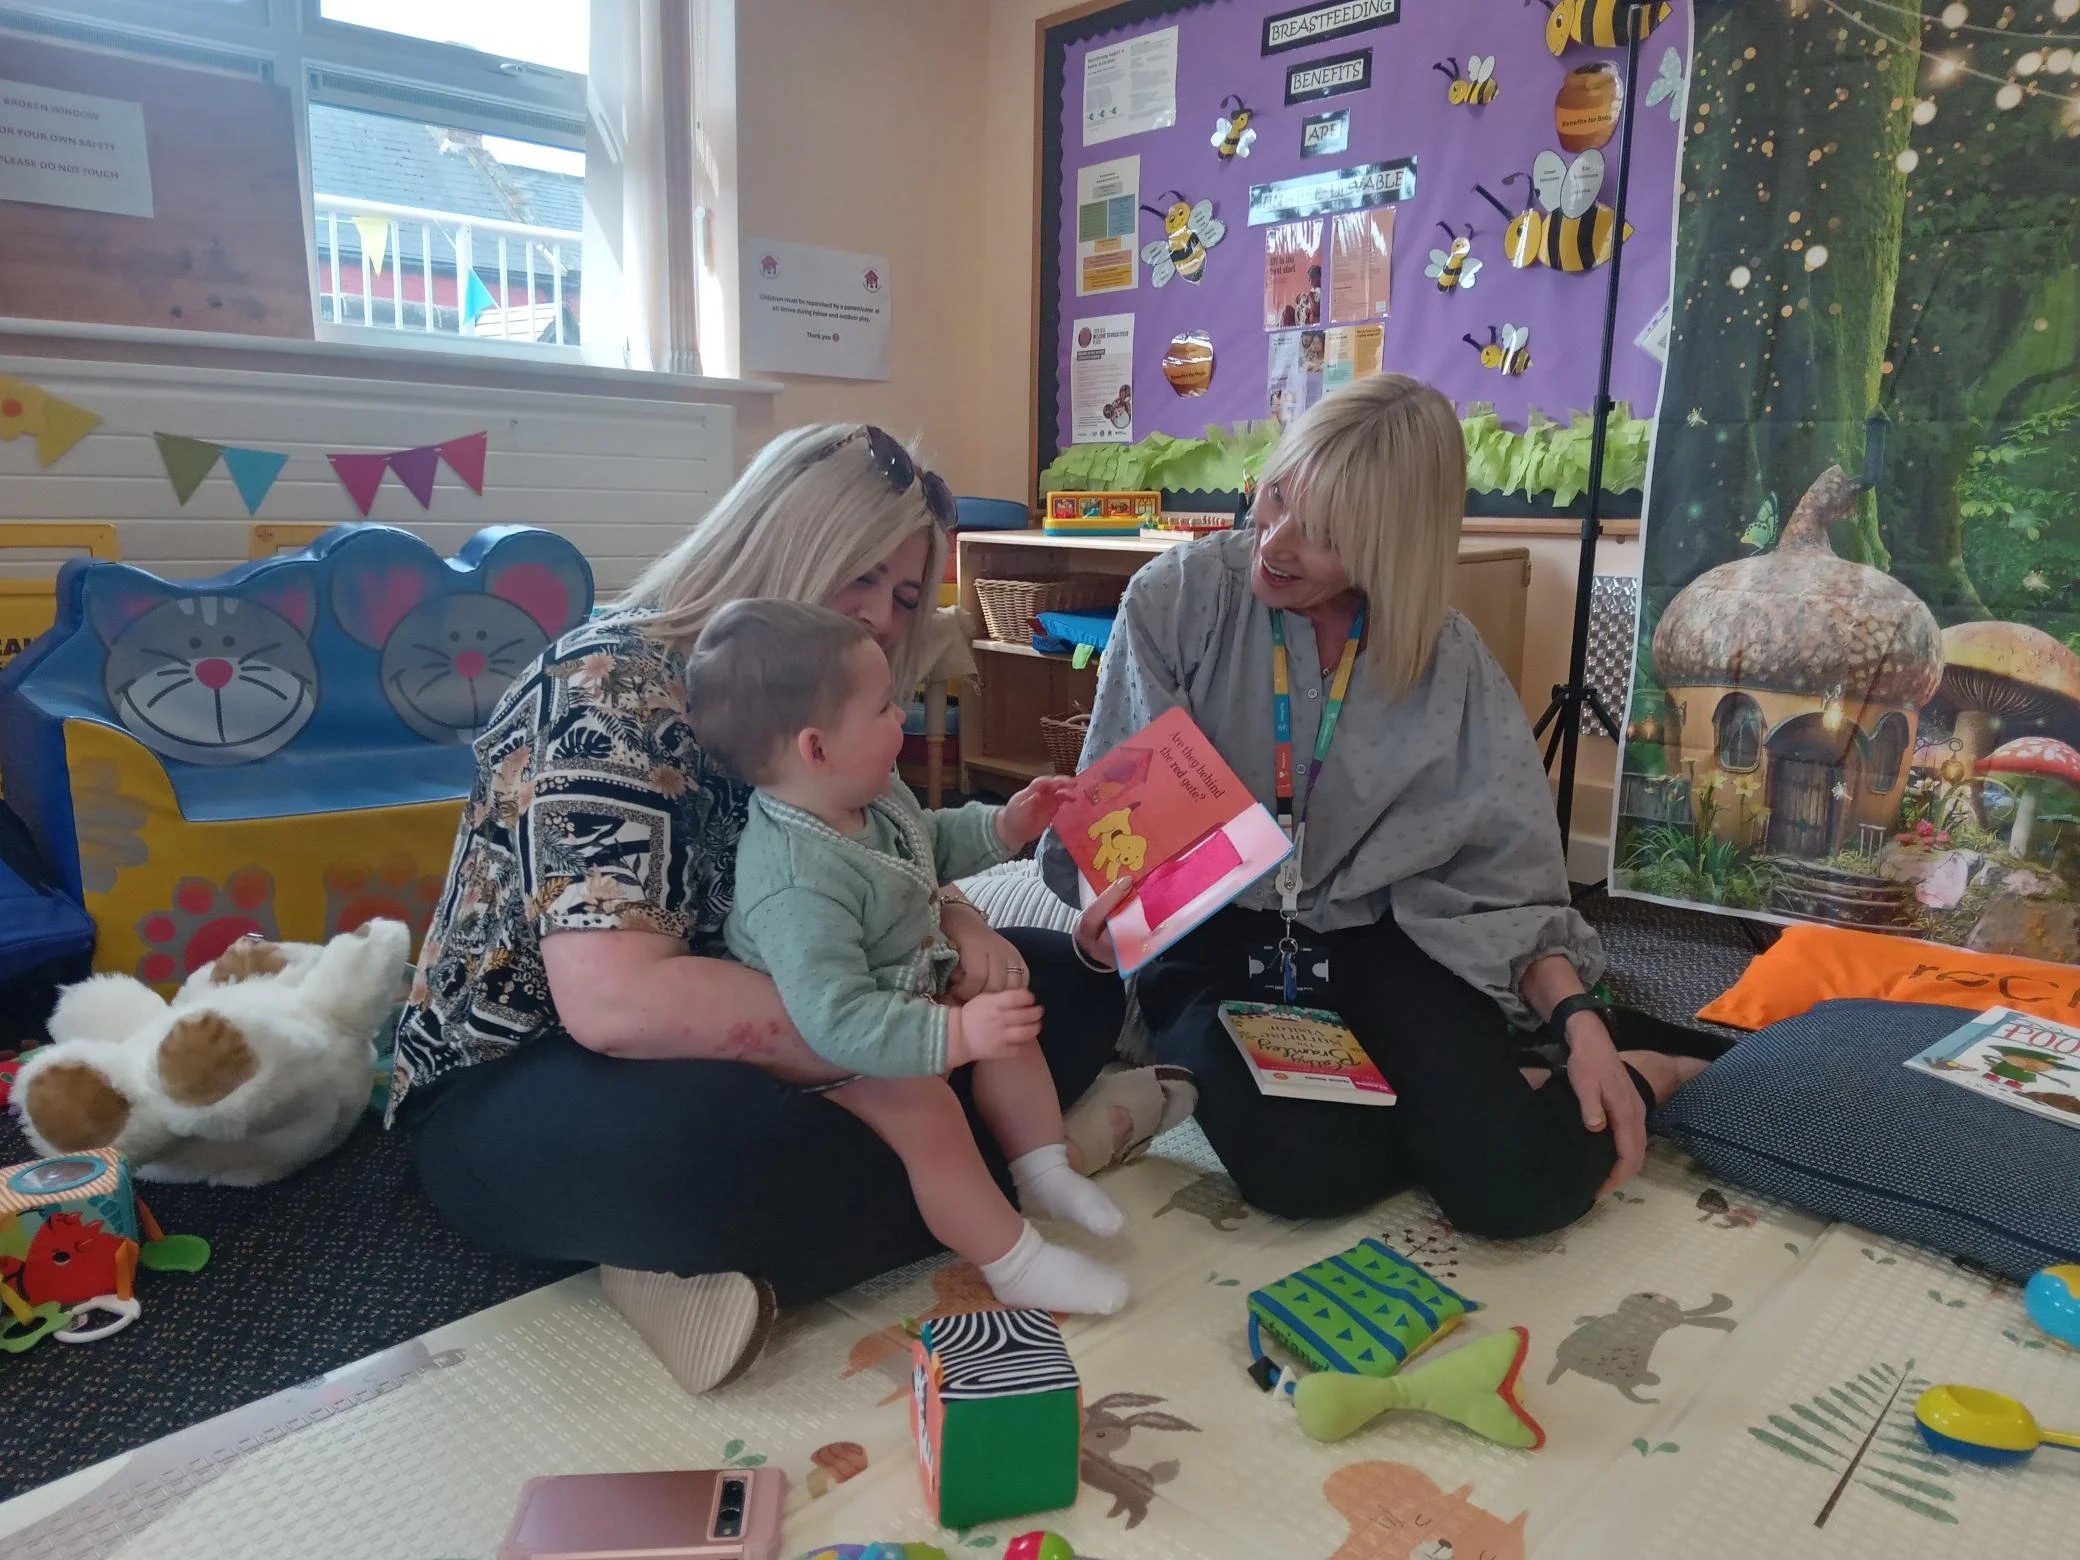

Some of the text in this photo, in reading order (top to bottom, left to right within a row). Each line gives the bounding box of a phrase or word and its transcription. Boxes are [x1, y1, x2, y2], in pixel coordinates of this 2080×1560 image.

[1271, 1, 1392, 41] BREASTFEEDING
[1293, 61, 1362, 91] BENEFITS
[3, 97, 100, 120] BROKEN WINDOW
[17, 128, 47, 141] YOUR
[49, 135, 76, 146] OWN
[78, 138, 115, 151] SAFETY
[40, 162, 56, 171] DO
[59, 164, 80, 174] NOT
[83, 168, 119, 179] TOUCH
[1160, 747, 1206, 803] the red gate?
[1169, 731, 1225, 799] Are they behind
[1257, 1038, 1361, 1067] Bramley
